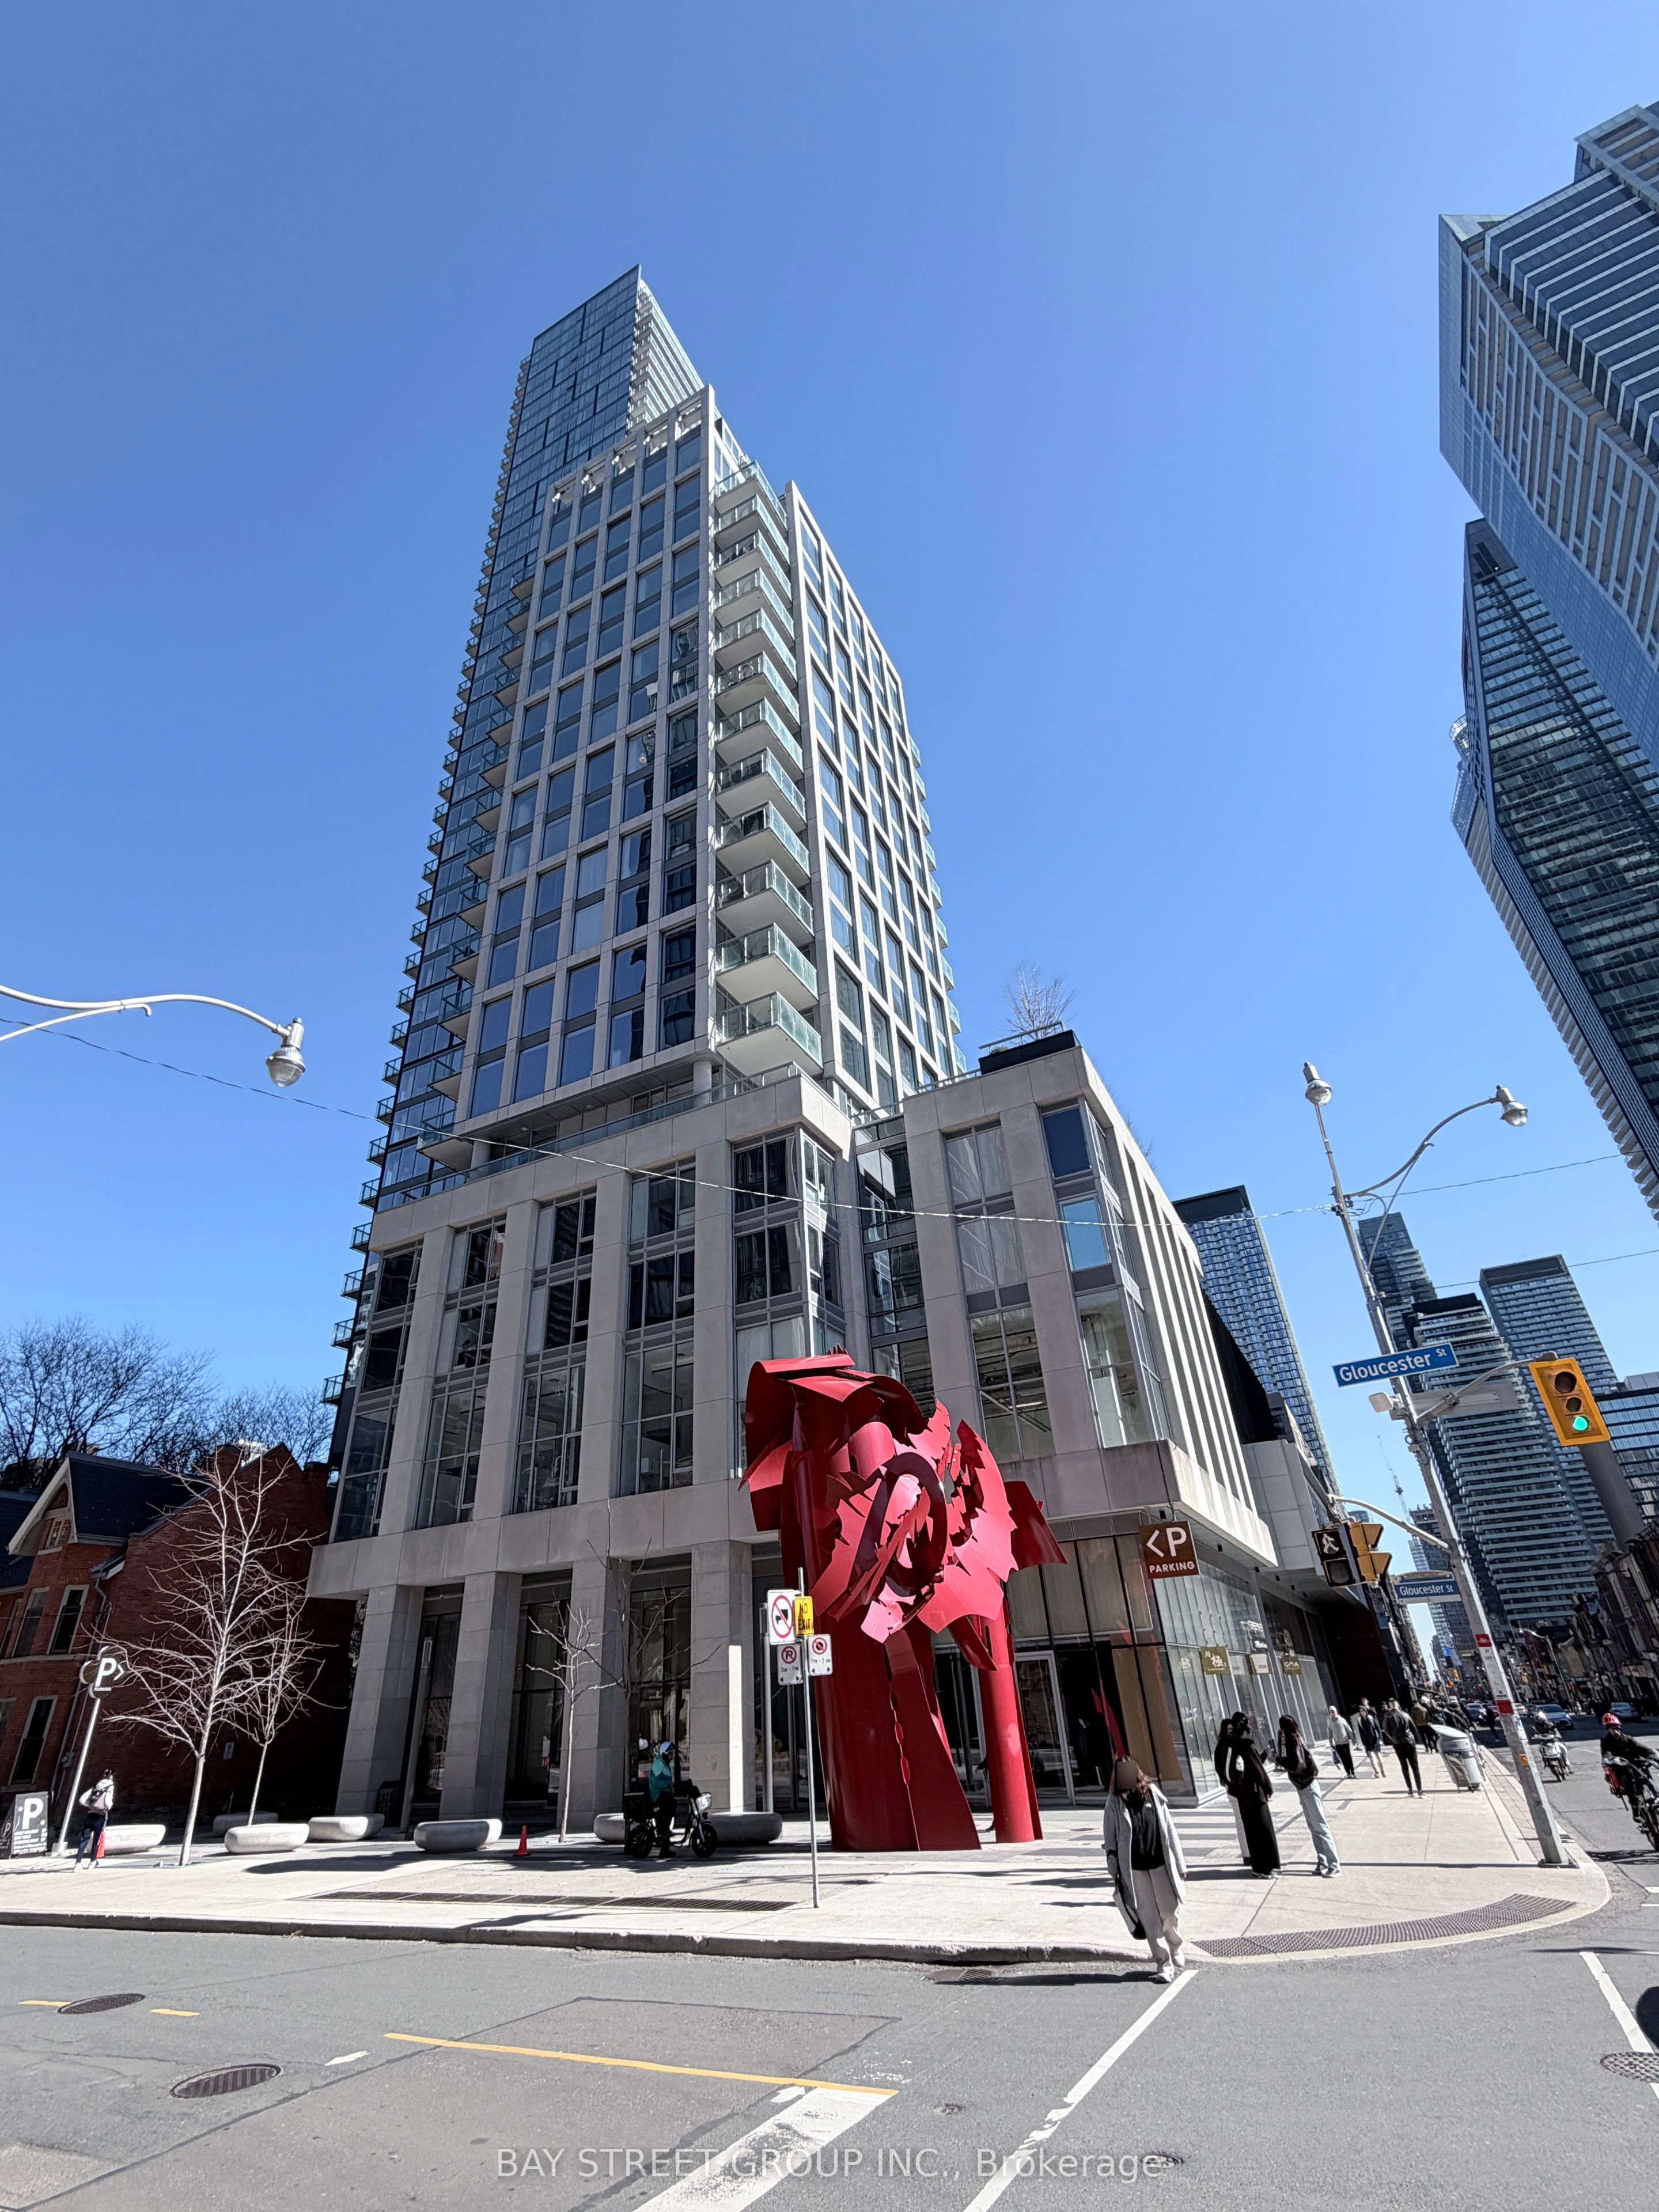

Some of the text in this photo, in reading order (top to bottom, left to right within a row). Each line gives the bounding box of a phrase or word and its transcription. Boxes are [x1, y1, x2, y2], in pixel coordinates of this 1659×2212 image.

[1339, 1348, 1448, 1382] Gloucester St
[1166, 1527, 1187, 1556] P
[1149, 1561, 1195, 1574] PARKING
[1400, 1585, 1444, 1596] Gloucester
[799, 1603, 808, 1614] NO
[798, 1619, 810, 1631] EXIT
[95, 1658, 116, 1687] P
[22, 1798, 44, 1830] P
